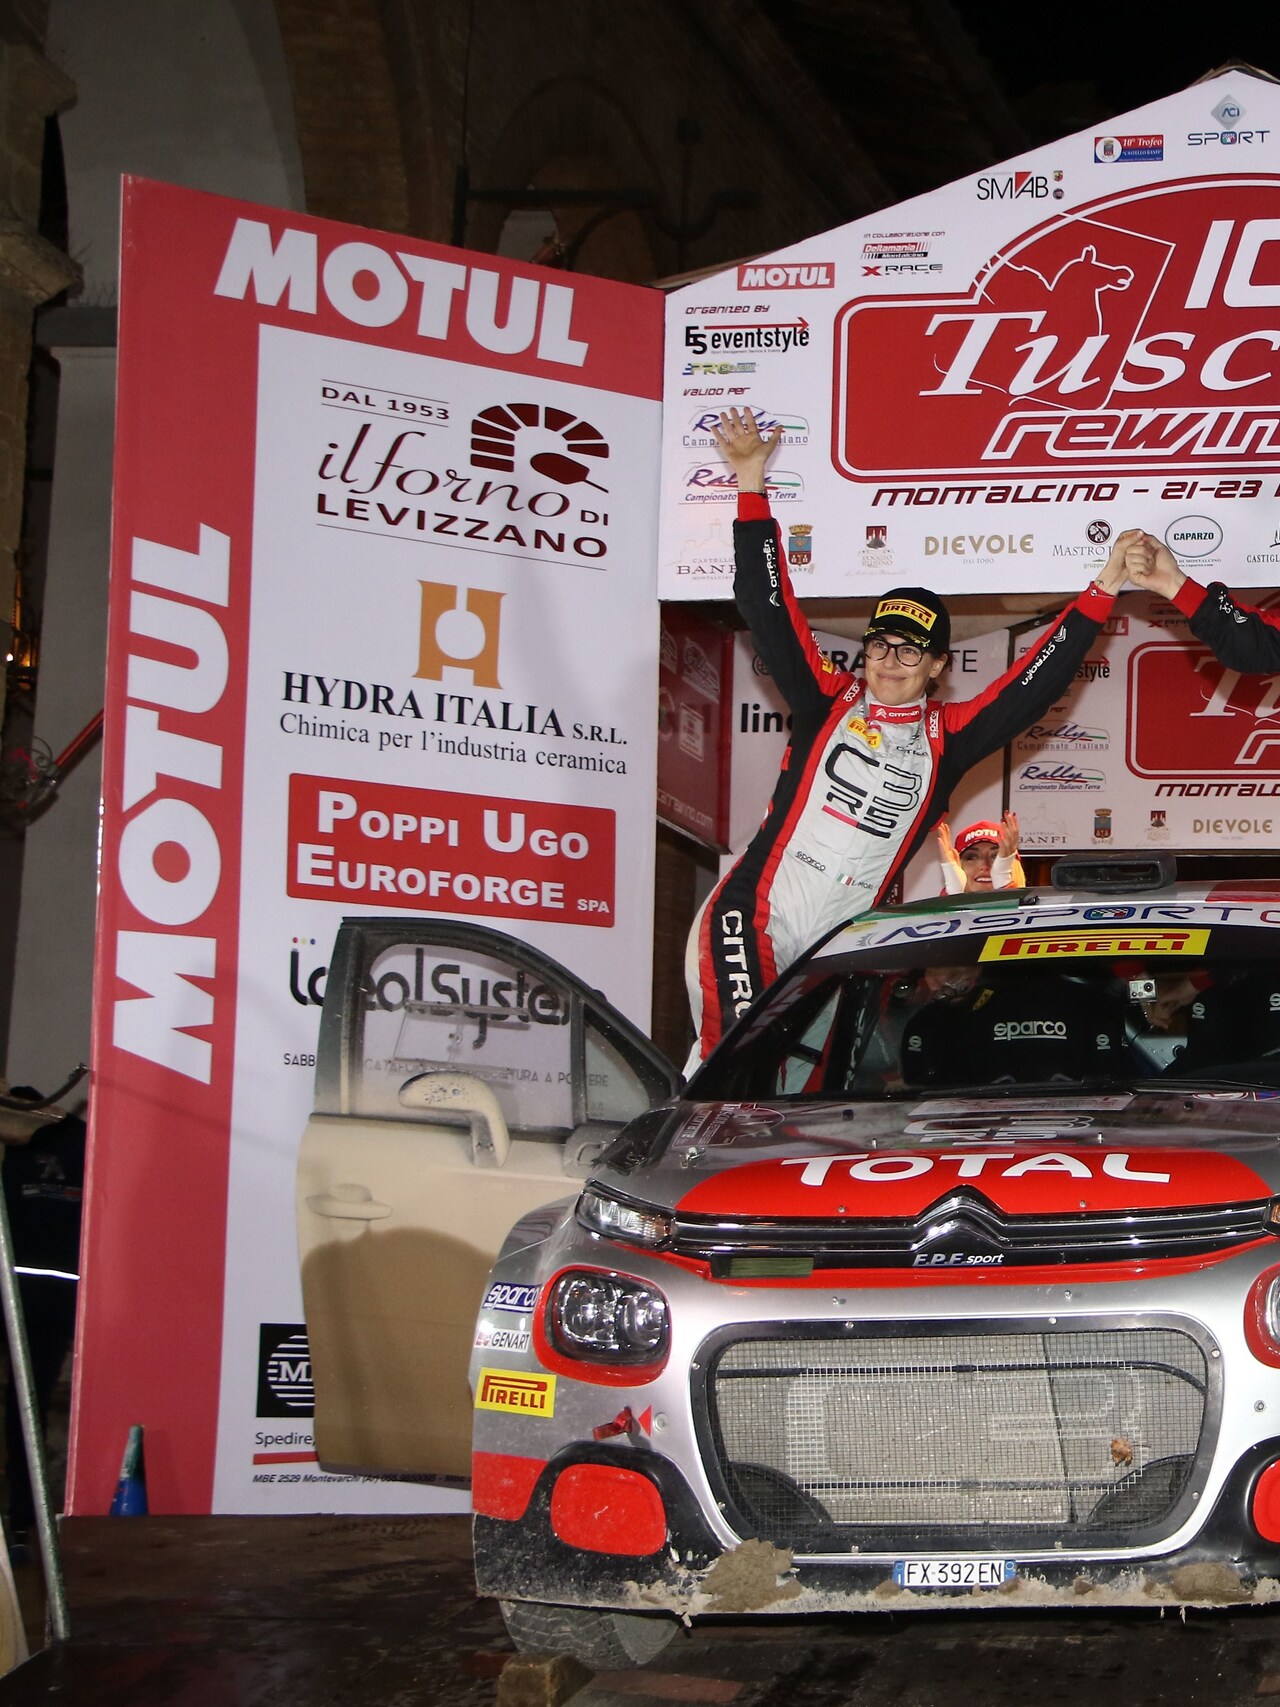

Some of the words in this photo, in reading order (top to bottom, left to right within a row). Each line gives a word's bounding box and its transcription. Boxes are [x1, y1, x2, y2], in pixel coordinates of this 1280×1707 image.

[1137, 137, 1163, 147] Trofeo
[1187, 130, 1270, 146] SPORT
[742, 266, 831, 287] MOTUL
[885, 264, 943, 272] RACE
[214, 218, 589, 367] MOTUL
[711, 327, 810, 353] eventstyle
[322, 386, 376, 407] DAL
[388, 399, 450, 420] 1953
[685, 494, 737, 503] Campionato
[1160, 478, 1262, 500] 21-23
[317, 493, 607, 558] LEVIZZANO
[581, 510, 609, 526] DI
[925, 534, 1034, 555] DIEVOLE
[1173, 532, 1214, 541] CAPARZO
[1052, 545, 1105, 556] MASTRO
[677, 566, 737, 575] BANF
[880, 602, 932, 625] PIRELLI
[282, 671, 423, 719] HYDRA
[435, 693, 565, 738] ITALIA
[573, 722, 628, 745] S.R.L.
[1025, 724, 1089, 742] Rally
[280, 712, 369, 743] Chimica
[379, 730, 412, 751] per
[536, 751, 627, 775] ceramica
[1017, 741, 1068, 750] Campionato
[1075, 742, 1109, 750] Italiano
[1021, 765, 1082, 783] Rally
[1019, 783, 1057, 791] Campionato
[113, 522, 231, 1085] MOTUL
[965, 829, 998, 842] MOTU
[1193, 819, 1272, 834] DIEVOLE
[795, 850, 826, 874] sparco
[577, 898, 610, 914] SPA
[968, 906, 1254, 931] SPORT
[1000, 932, 1190, 955] PIRELLI
[993, 1021, 1067, 1041] sparco
[782, 1152, 1172, 1186] TOTAL
[966, 1253, 1004, 1265] sport
[491, 1331, 529, 1350] GENART
[481, 1375, 548, 1409] PIRELLI
[253, 1475, 276, 1483] MBE
[278, 1475, 300, 1483] 2529
[907, 1562, 931, 1584] FX
